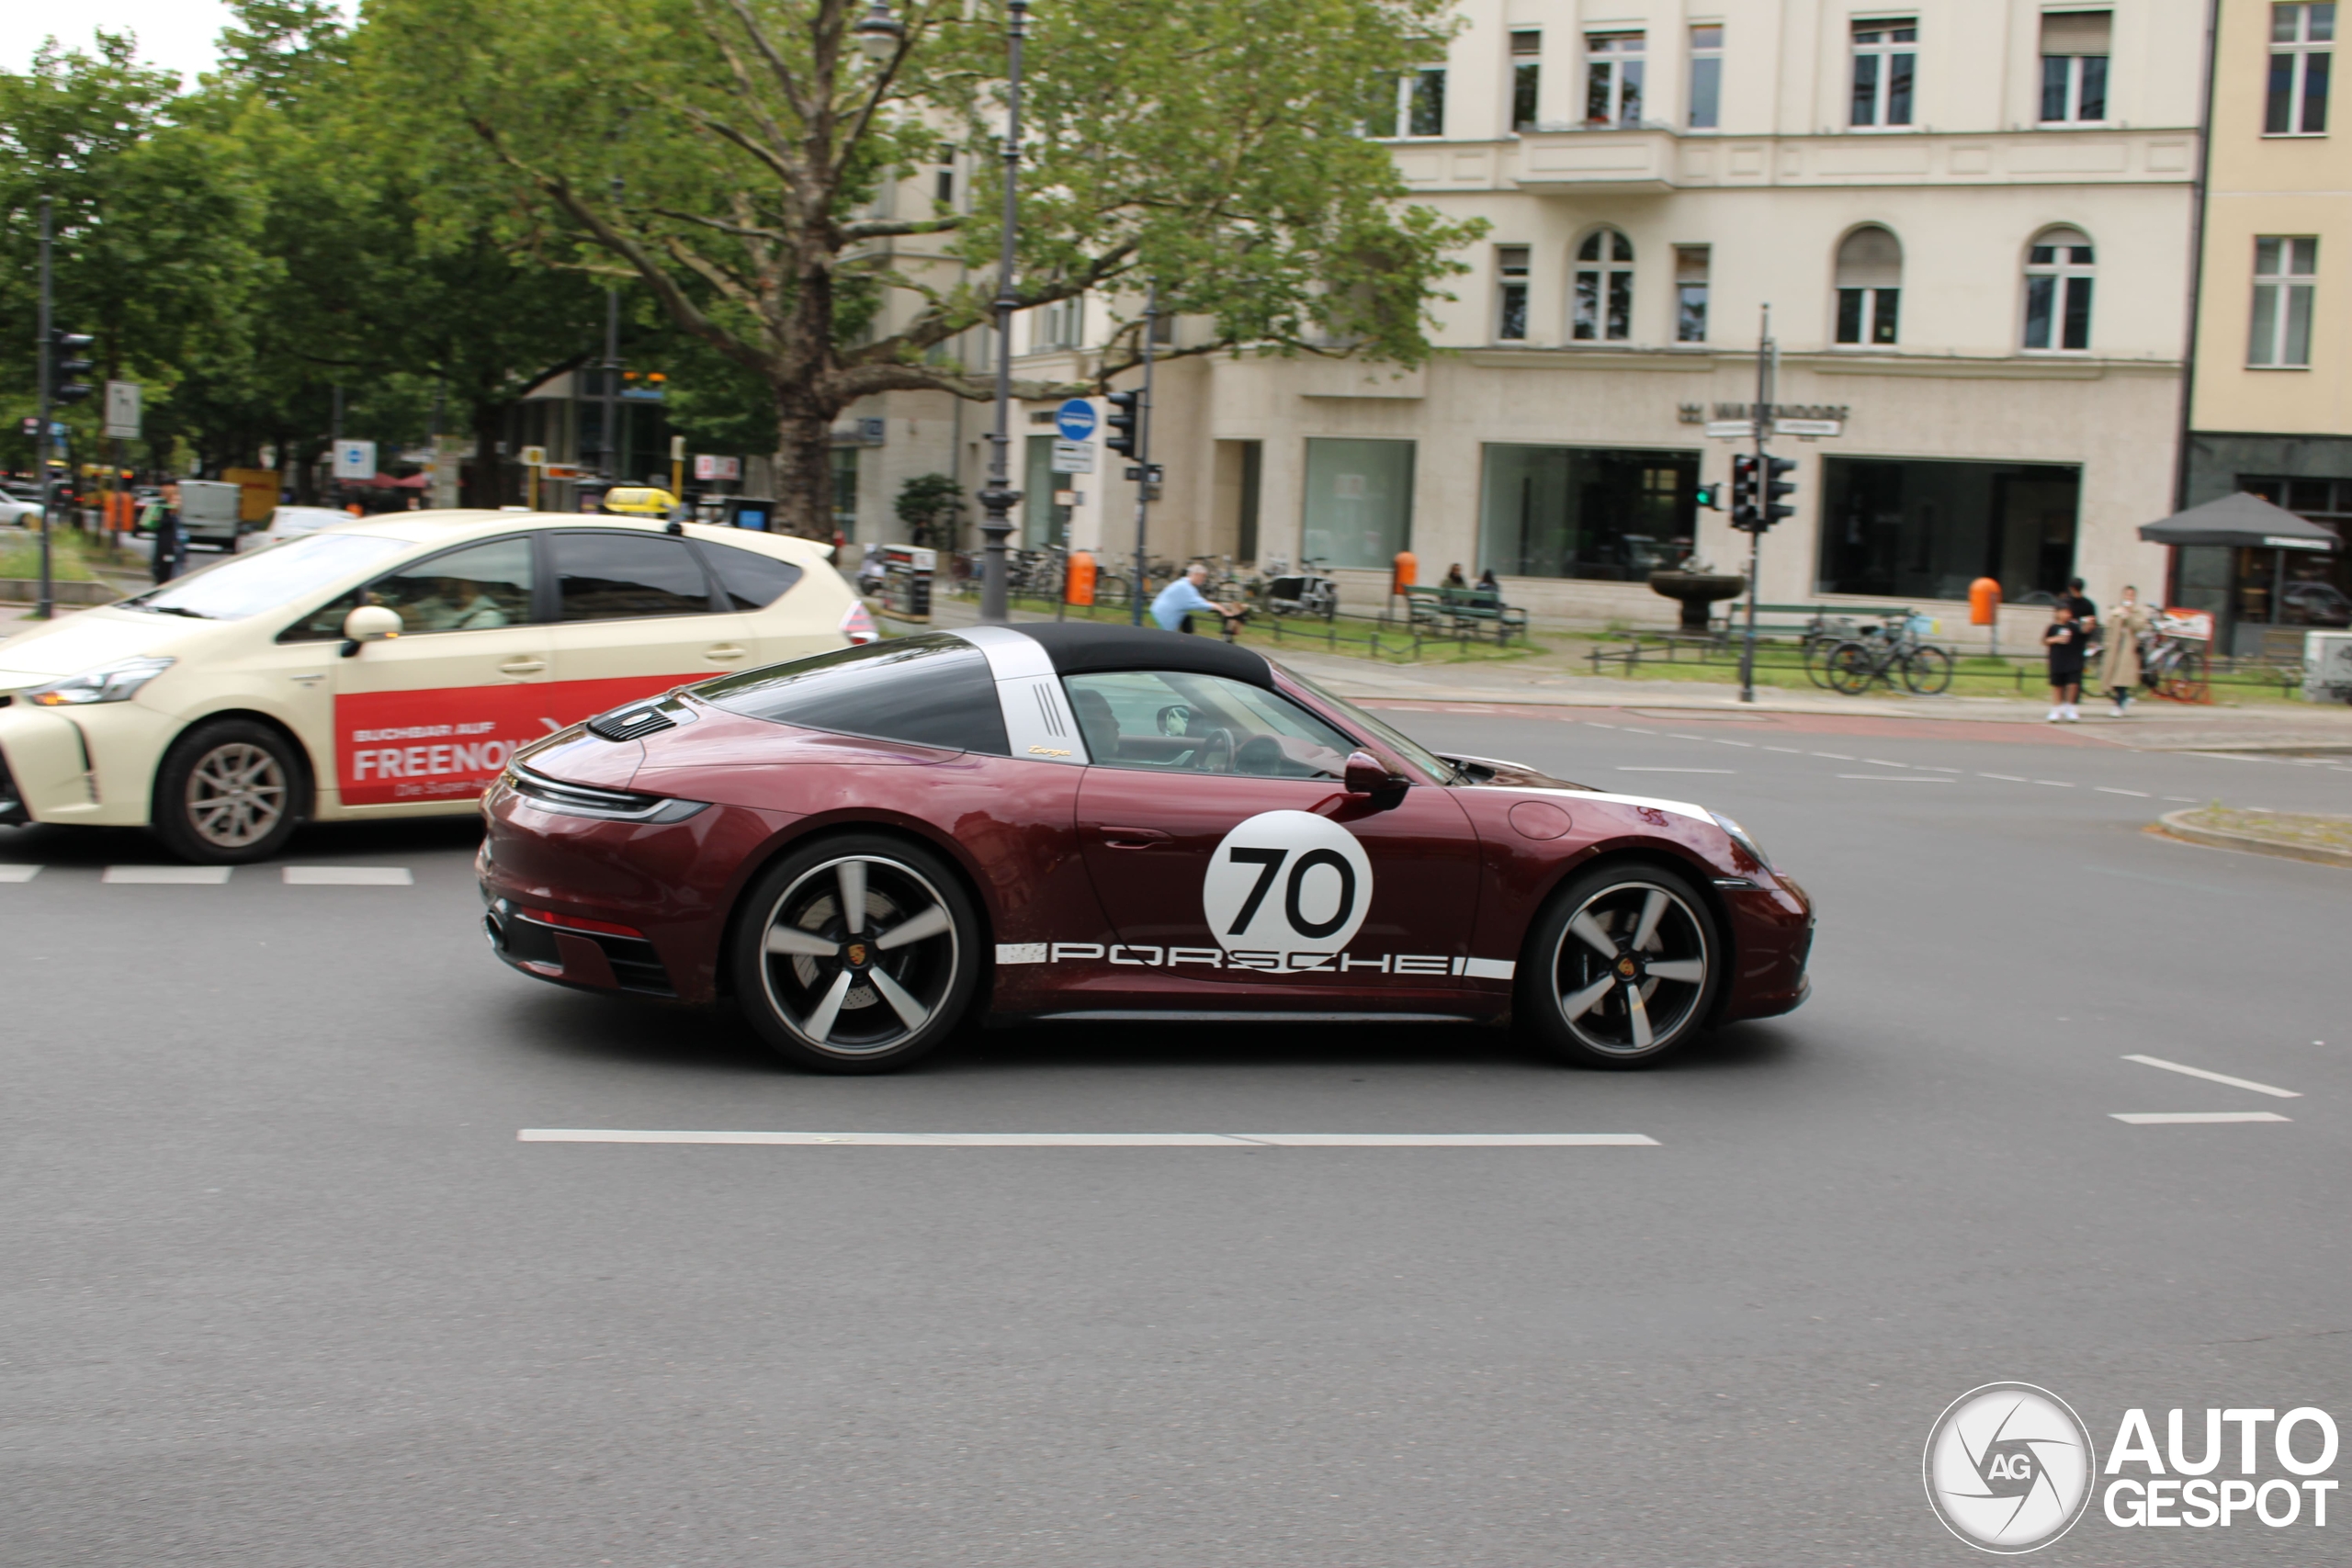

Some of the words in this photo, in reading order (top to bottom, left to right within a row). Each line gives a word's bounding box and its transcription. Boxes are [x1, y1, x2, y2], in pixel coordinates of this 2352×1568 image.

[1713, 402, 1849, 420] WAENDORF
[353, 725, 451, 742] BUCHBAR
[456, 721, 495, 735] AUF
[1227, 847, 1356, 939] 70
[1050, 942, 1447, 976] PORSCHE
